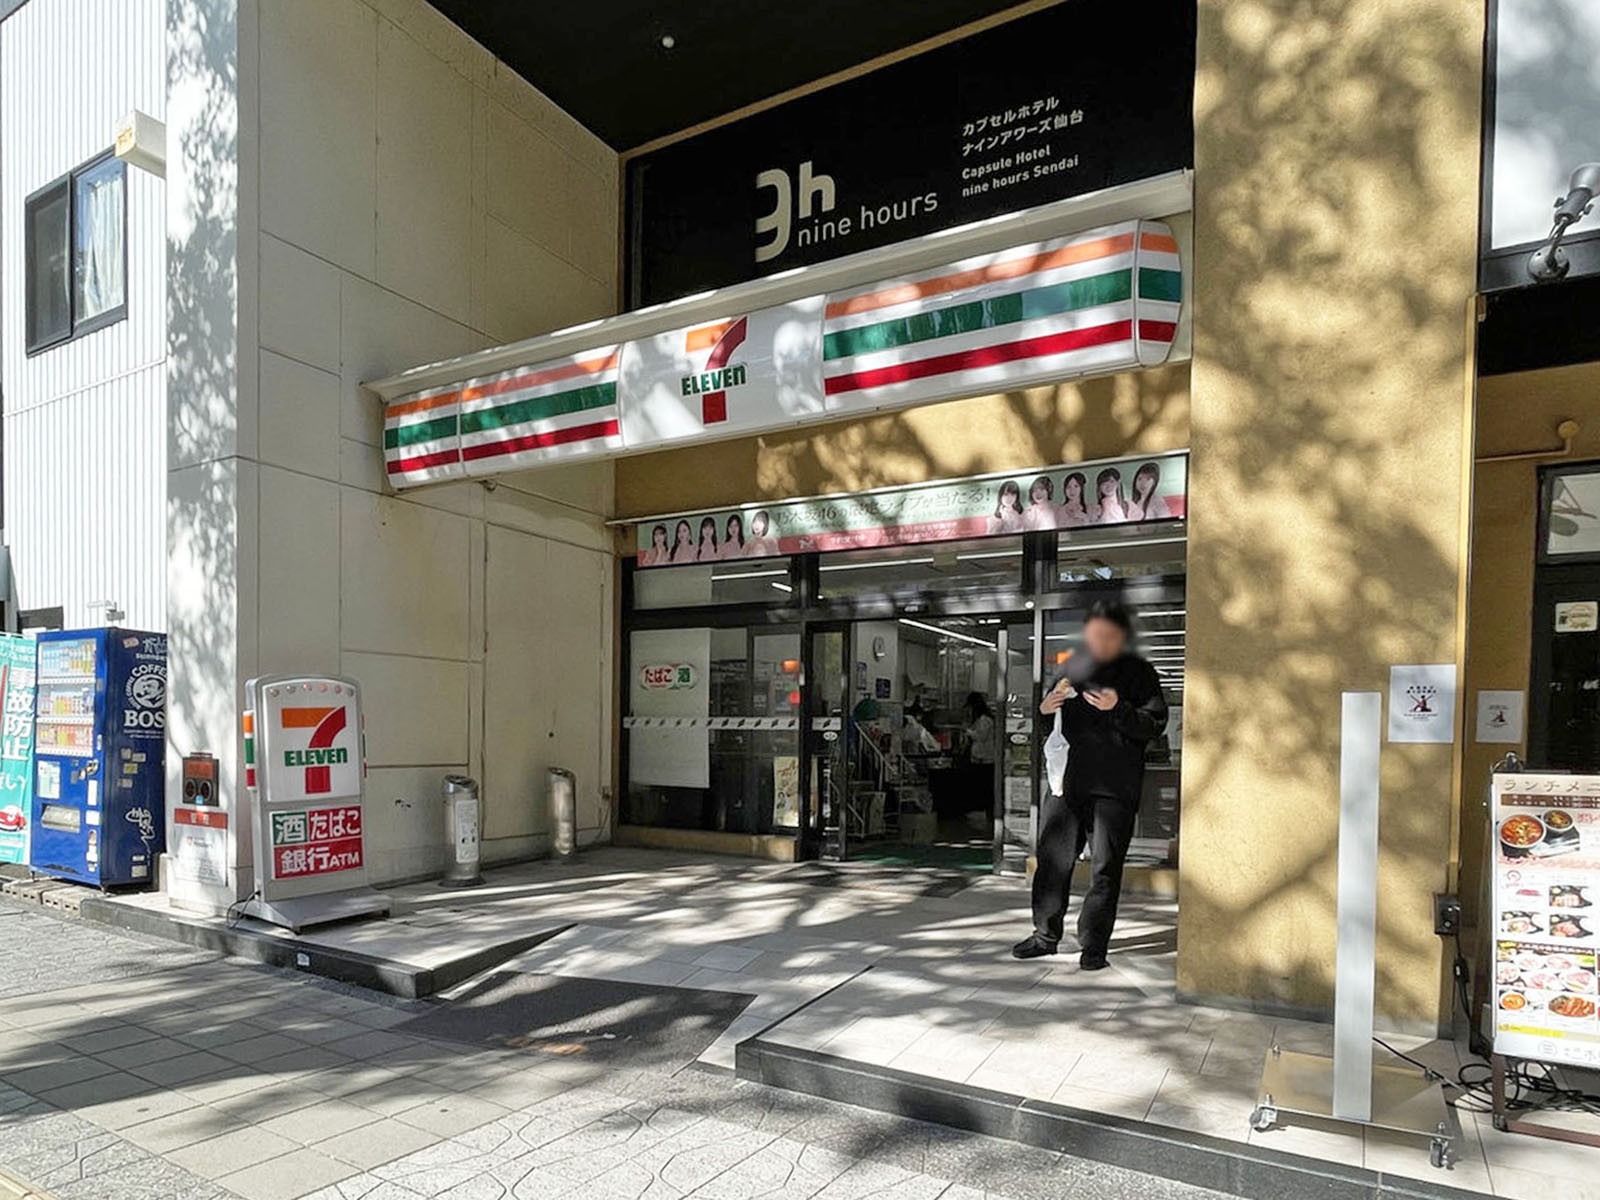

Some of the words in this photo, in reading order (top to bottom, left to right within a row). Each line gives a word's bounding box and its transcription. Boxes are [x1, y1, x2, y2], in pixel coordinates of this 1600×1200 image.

[962, 96, 1060, 137] カプセルホテル
[962, 109, 1084, 157] ナインアワーズ仙台
[962, 157, 1013, 179] Capsule
[1015, 144, 1051, 165] Hotel
[962, 182, 989, 197] nine
[992, 170, 1030, 189] hours
[1033, 154, 1079, 178] Sendai
[798, 216, 851, 247] nine
[860, 192, 938, 230] hours
[644, 668, 673, 683] たばこ
[275, 815, 306, 845] 酒
[310, 809, 361, 840] たばこ
